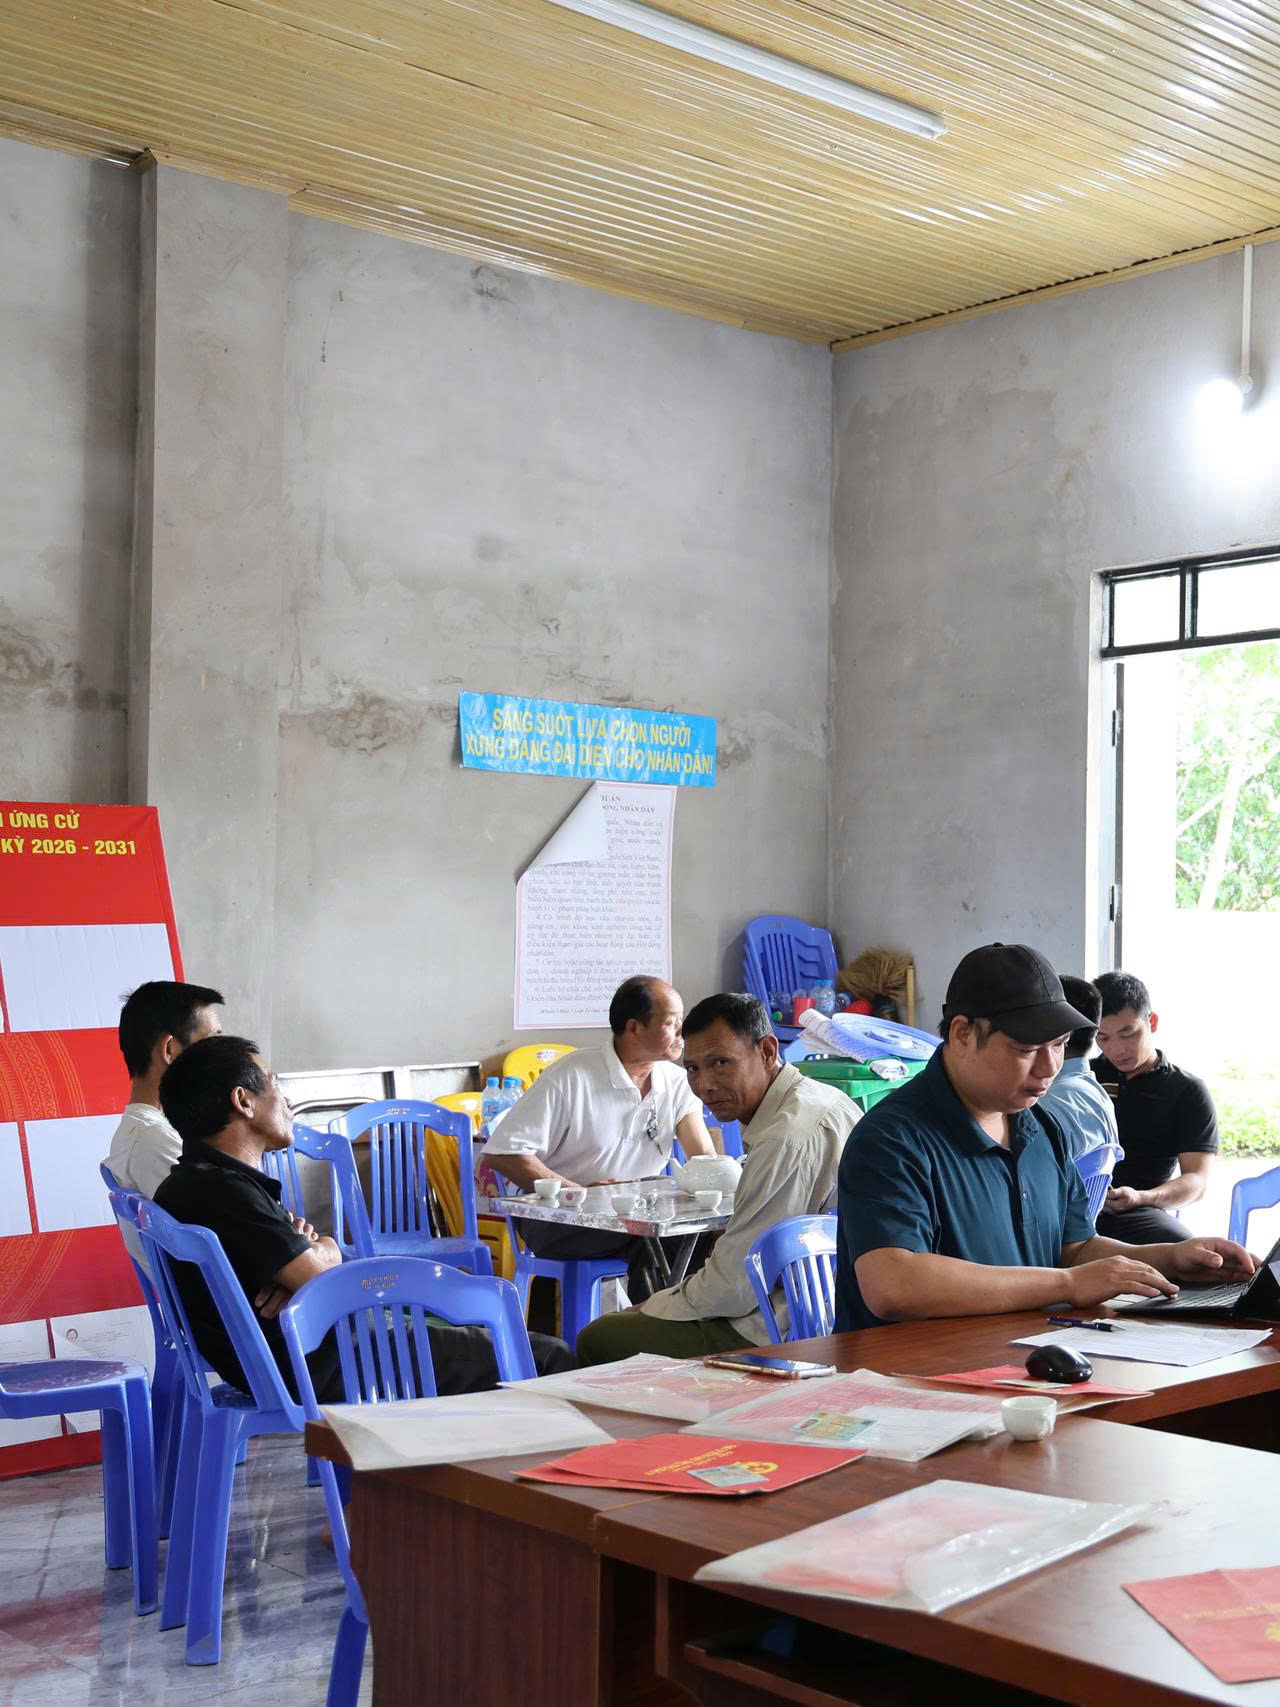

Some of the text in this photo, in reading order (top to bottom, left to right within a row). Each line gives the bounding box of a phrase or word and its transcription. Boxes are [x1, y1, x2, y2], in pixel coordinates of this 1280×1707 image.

[615, 746, 645, 769] CHO
[8, 809, 49, 829] ỨNG
[54, 809, 80, 829] CỬ
[0, 835, 25, 854] KỲ
[31, 839, 77, 854] 2026
[94, 840, 137, 855] 2031
